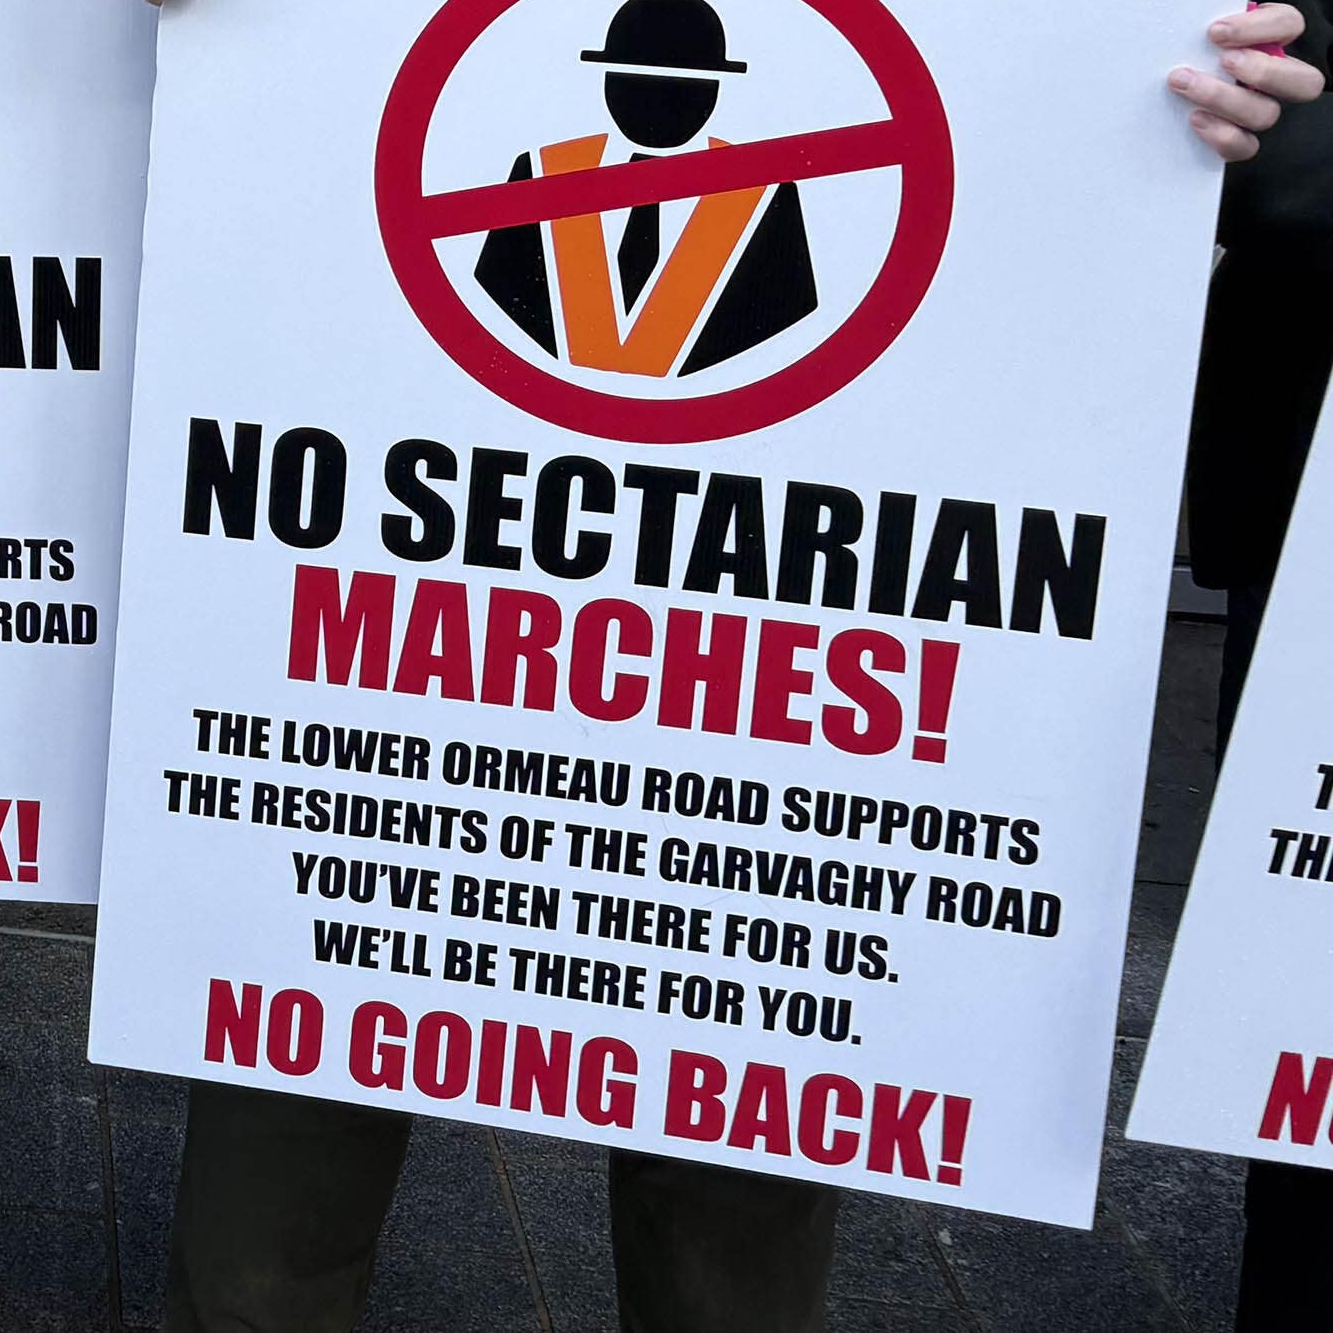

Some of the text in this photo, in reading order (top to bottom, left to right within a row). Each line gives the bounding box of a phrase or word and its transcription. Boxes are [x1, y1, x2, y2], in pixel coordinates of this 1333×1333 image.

[183, 418, 1106, 640] NO SECTARIAN
[288, 564, 960, 763] MARCHES!
[164, 770, 1061, 937] THE RESIDENTS OF THE GARVAGHY ROAD
[193, 709, 1039, 865] THE LOWER ORMEAU ROAD SUPPORTS
[444, 939, 497, 987] BE
[509, 948, 646, 1010] THERE
[658, 971, 744, 1025] FOR
[758, 986, 861, 1045] YOU.
[451, 874, 560, 930] BEEN
[572, 891, 711, 953] THERE
[723, 914, 811, 968] FOR
[825, 929, 898, 982] US.
[204, 979, 971, 1186] NO GOING BACK!
[1257, 1051, 1333, 1146] N
